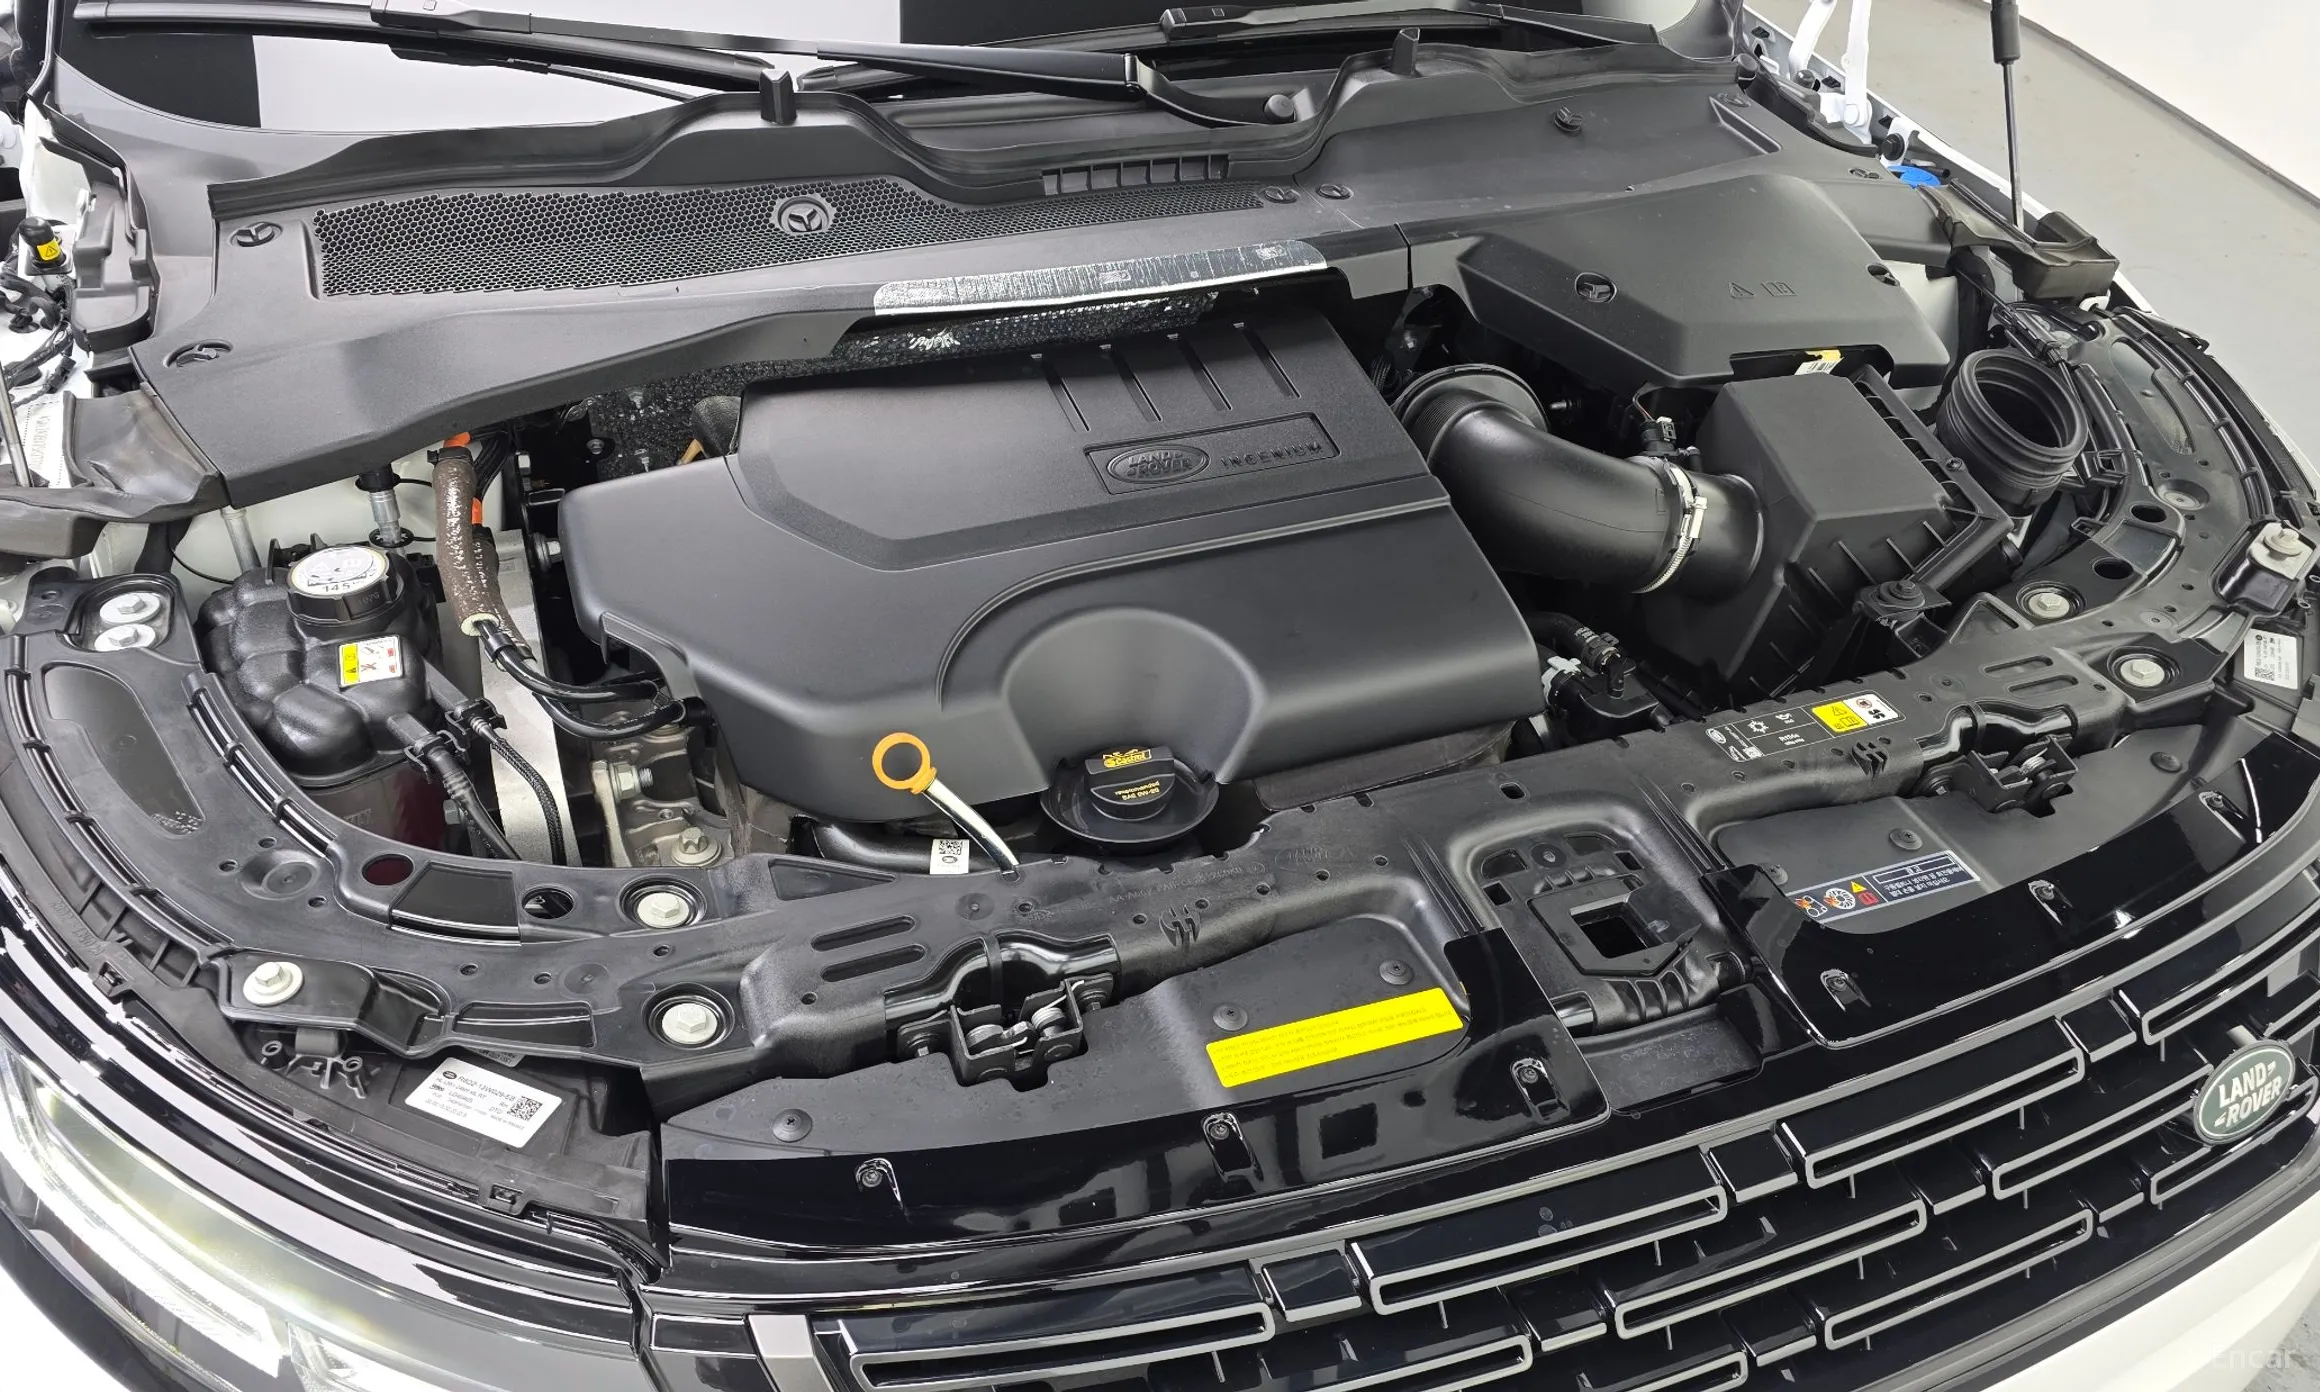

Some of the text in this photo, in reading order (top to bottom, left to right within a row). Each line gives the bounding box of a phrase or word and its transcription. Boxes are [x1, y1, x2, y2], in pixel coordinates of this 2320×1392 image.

[1115, 751, 1146, 766] Castrol
[2219, 1061, 2268, 1108] LAND
[2225, 1075, 2283, 1128] ROVER
